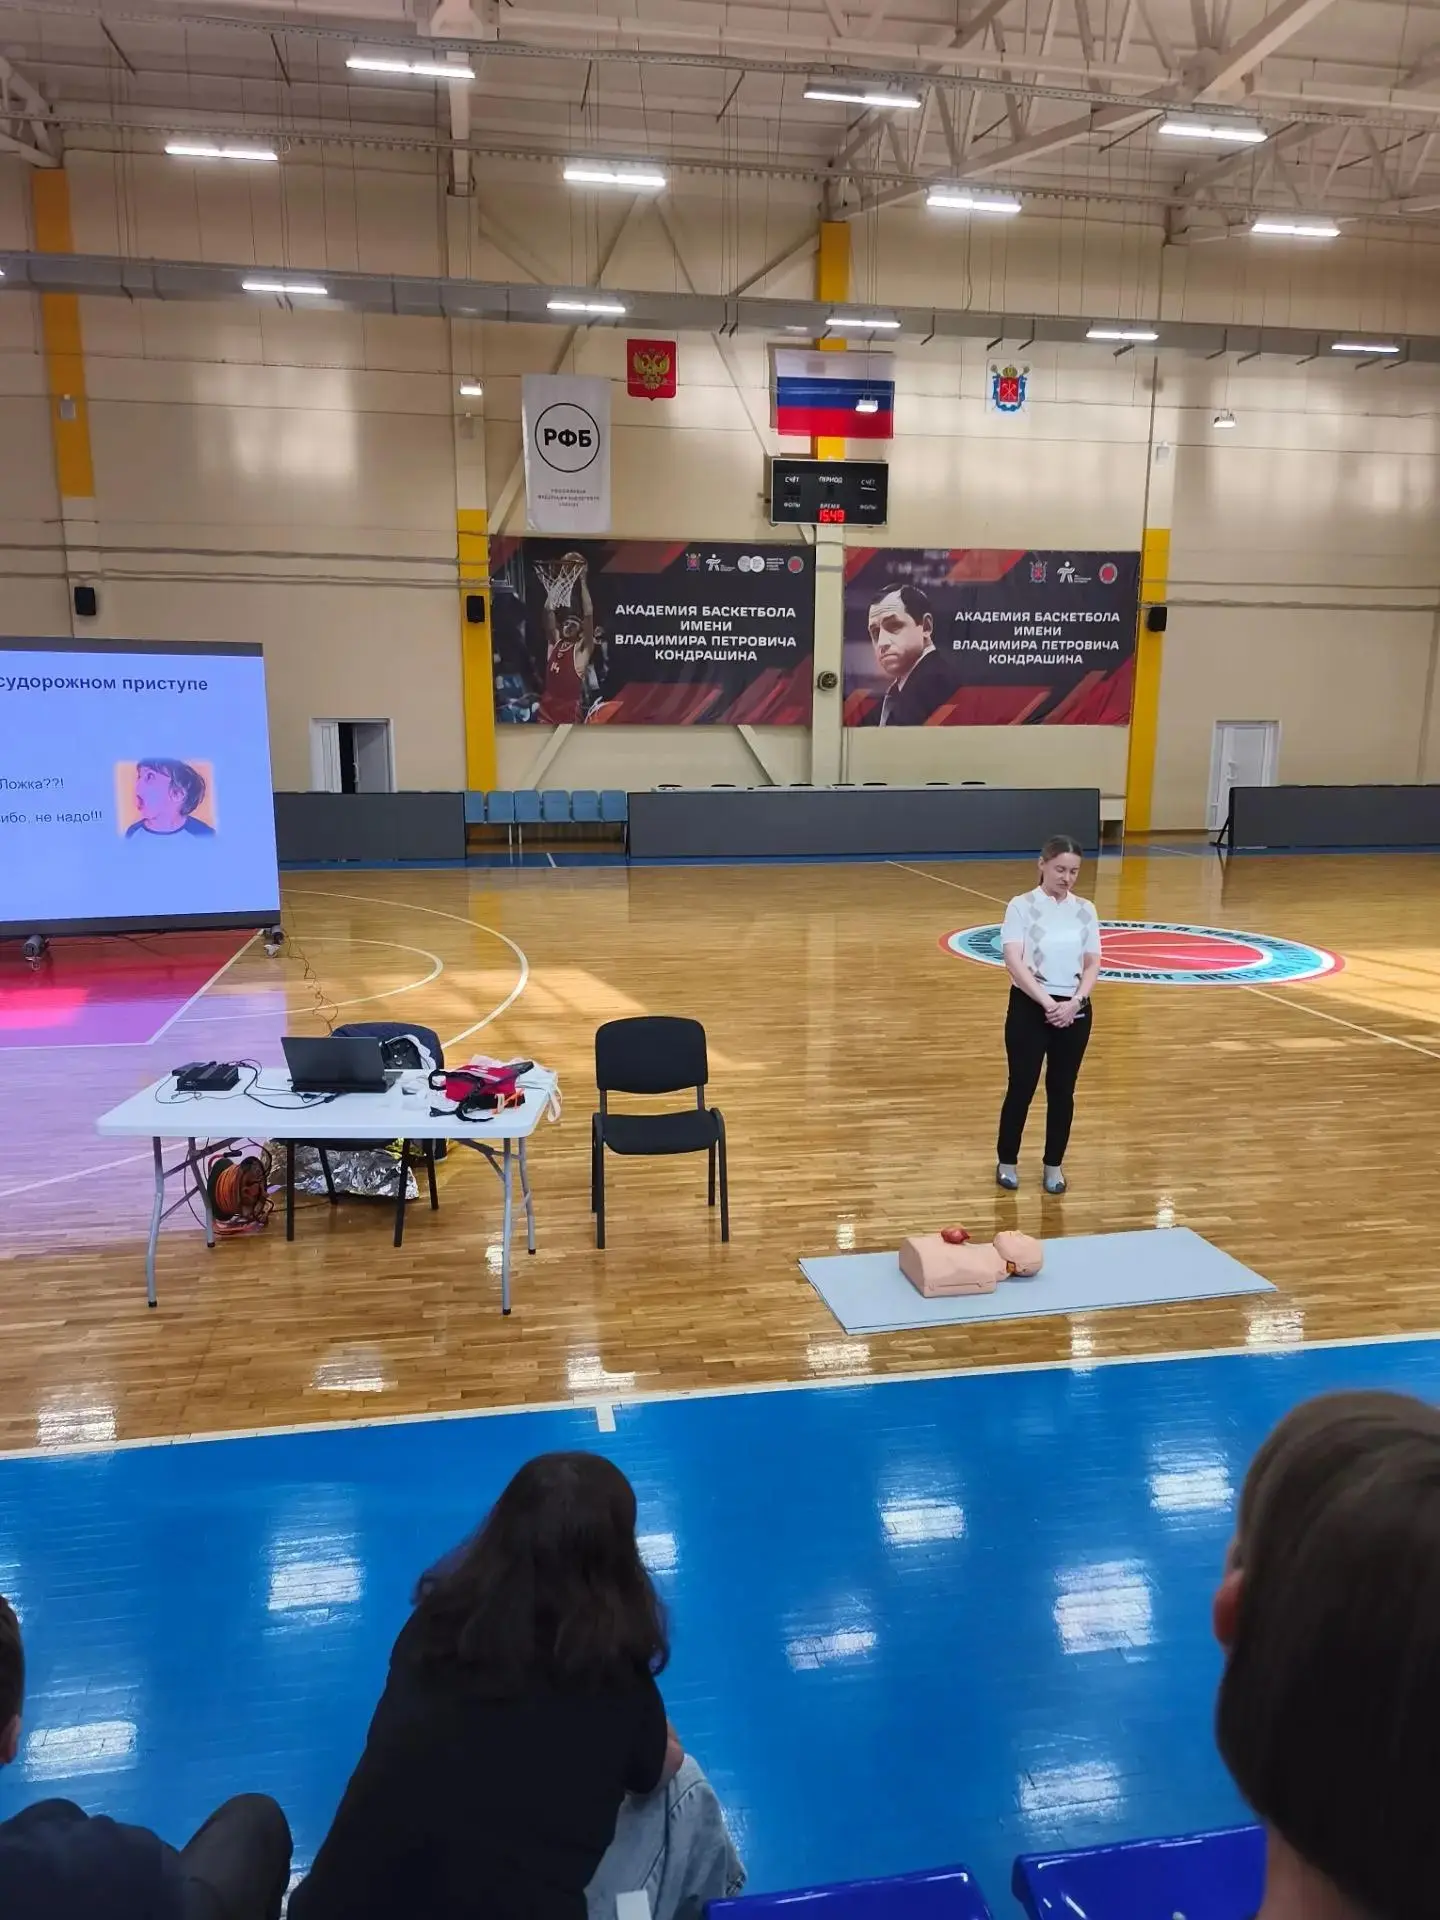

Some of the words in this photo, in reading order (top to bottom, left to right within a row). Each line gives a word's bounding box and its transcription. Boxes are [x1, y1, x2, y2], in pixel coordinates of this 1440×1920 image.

[544, 428, 592, 447] РФБ
[615, 604, 697, 617] АКАДЕМИЯ
[702, 605, 796, 618] БАСКЕТБОЛА
[954, 611, 1031, 623] АКАДЕМИЯ
[1035, 611, 1120, 623] БАСКЕТБОЛА
[680, 620, 732, 632] ИМЕНИ
[1014, 626, 1062, 636] ИМЕНИ
[615, 634, 707, 647] ВЛАДИМИРА
[711, 635, 796, 648] ПЕТРОВИЧА
[953, 640, 1037, 651] ВЛАДИМИРА
[1042, 640, 1119, 651] ПЕТРОВИЧА
[654, 649, 758, 662] КОНДРАШИНА
[989, 654, 1083, 665] КОНДРАШИНА
[0, 676, 116, 691] судорожном
[122, 678, 208, 693] приступе
[0, 777, 64, 790] Ложка??!
[35, 814, 52, 823] не
[56, 810, 102, 823] надо!!!
